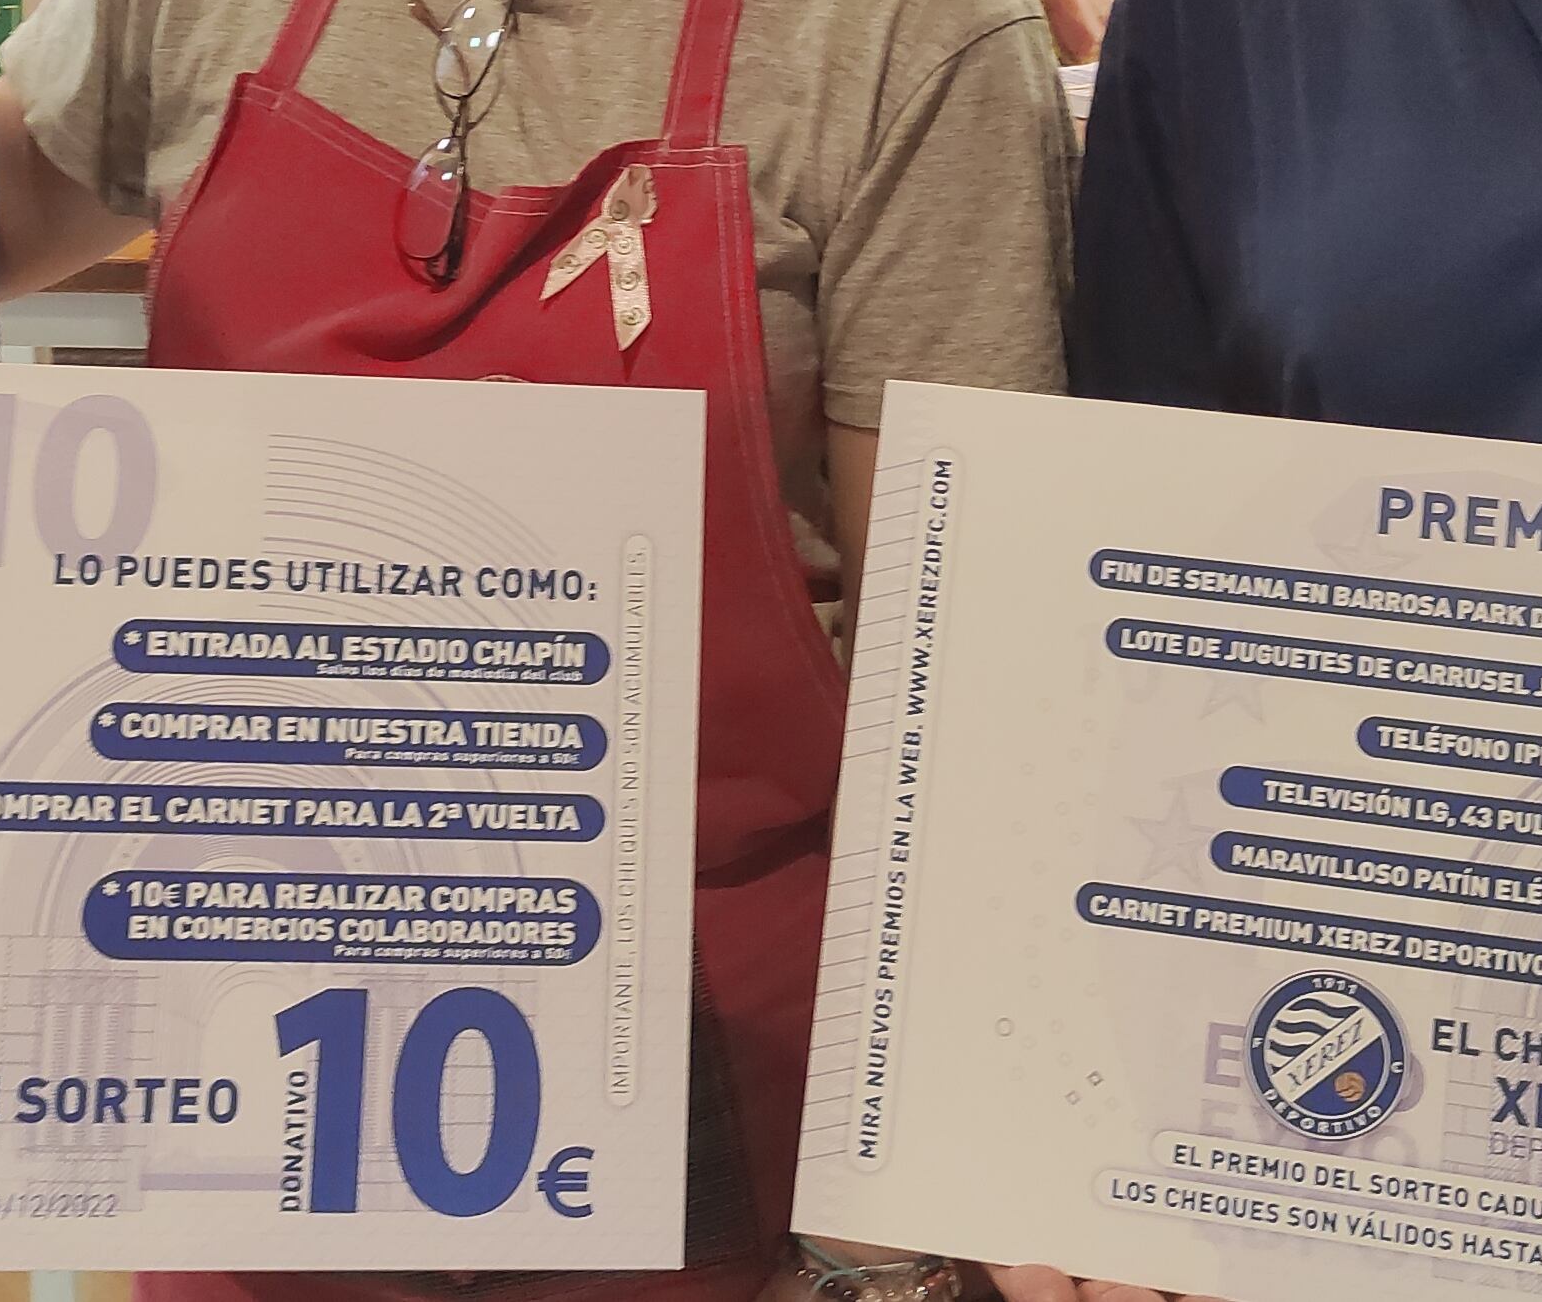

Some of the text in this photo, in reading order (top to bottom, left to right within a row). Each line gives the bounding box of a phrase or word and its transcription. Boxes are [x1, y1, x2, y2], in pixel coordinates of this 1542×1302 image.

[54, 554, 597, 602] LO PUEDES UTILIZAR COMO:
[1099, 560, 1143, 584] FIN
[1147, 565, 1181, 588] DE
[1184, 568, 1290, 600] SEMANA
[1293, 581, 1329, 605] EN
[1333, 584, 1453, 620] BARROSA
[1457, 599, 1527, 628] PARK
[146, 632, 586, 668] ENTRADA AL ESTADIO CHAPÍN
[1120, 628, 1185, 655] LOTE
[1187, 636, 1221, 660] DE
[1223, 640, 1354, 675] JUGUETES
[1357, 655, 1393, 680] DE
[1396, 660, 1530, 697] CARRUSEL
[120, 712, 584, 749] COMPRAR EN NUESTRA TIENDA
[623, 712, 642, 755] SON
[1376, 724, 1508, 763] TELÉFONO
[344, 747, 537, 765] Para compras superiores
[622, 761, 641, 790] NO
[119, 795, 161, 823] EL
[165, 796, 291, 826] CARNET
[296, 799, 379, 829] PARA
[382, 802, 422, 830] LA
[427, 802, 464, 830] 2ª
[467, 803, 581, 832] VUELTA
[858, 460, 953, 1160] MIRA NUEVOS PREMIOS EN LA WEB. WWW.XEREZDFC.COM
[1263, 779, 1412, 820] TELEVISIÓN
[1414, 798, 1457, 828] LG,
[1459, 804, 1493, 831] 43
[1230, 843, 1410, 888] MARAVILLOSO
[1413, 866, 1491, 899] PATÍN
[128, 880, 577, 915] 10€ PARA REALIZAR COMPRAS
[128, 915, 576, 946] EN COMERCIOS COLABORADORES
[617, 904, 636, 943] LOS
[1089, 894, 1191, 928] CARNET
[1193, 908, 1315, 945] PREMIUM
[1316, 924, 1402, 957] XEREZ
[333, 945, 372, 957] Para
[374, 947, 441, 960] compras
[1311, 976, 1359, 996] 1911
[1286, 1016, 1365, 1093] XEREZ
[1431, 1018, 1480, 1057] EL
[15, 1076, 240, 1126] SORTEO
[1262, 1088, 1383, 1133] DEPORTIVO
[280, 1070, 309, 1213] DONATIVO
[1173, 1144, 1202, 1168] EL
[1211, 1149, 1306, 1183] PREMIO
[1313, 1165, 1362, 1192] DEL
[1370, 1173, 1469, 1208] SORTEO
[1111, 1178, 1157, 1204] LOS
[1165, 1187, 1279, 1224] CHEQUES
[1286, 1206, 1338, 1233] SON
[1347, 1211, 1454, 1250] VÁLIDOS
